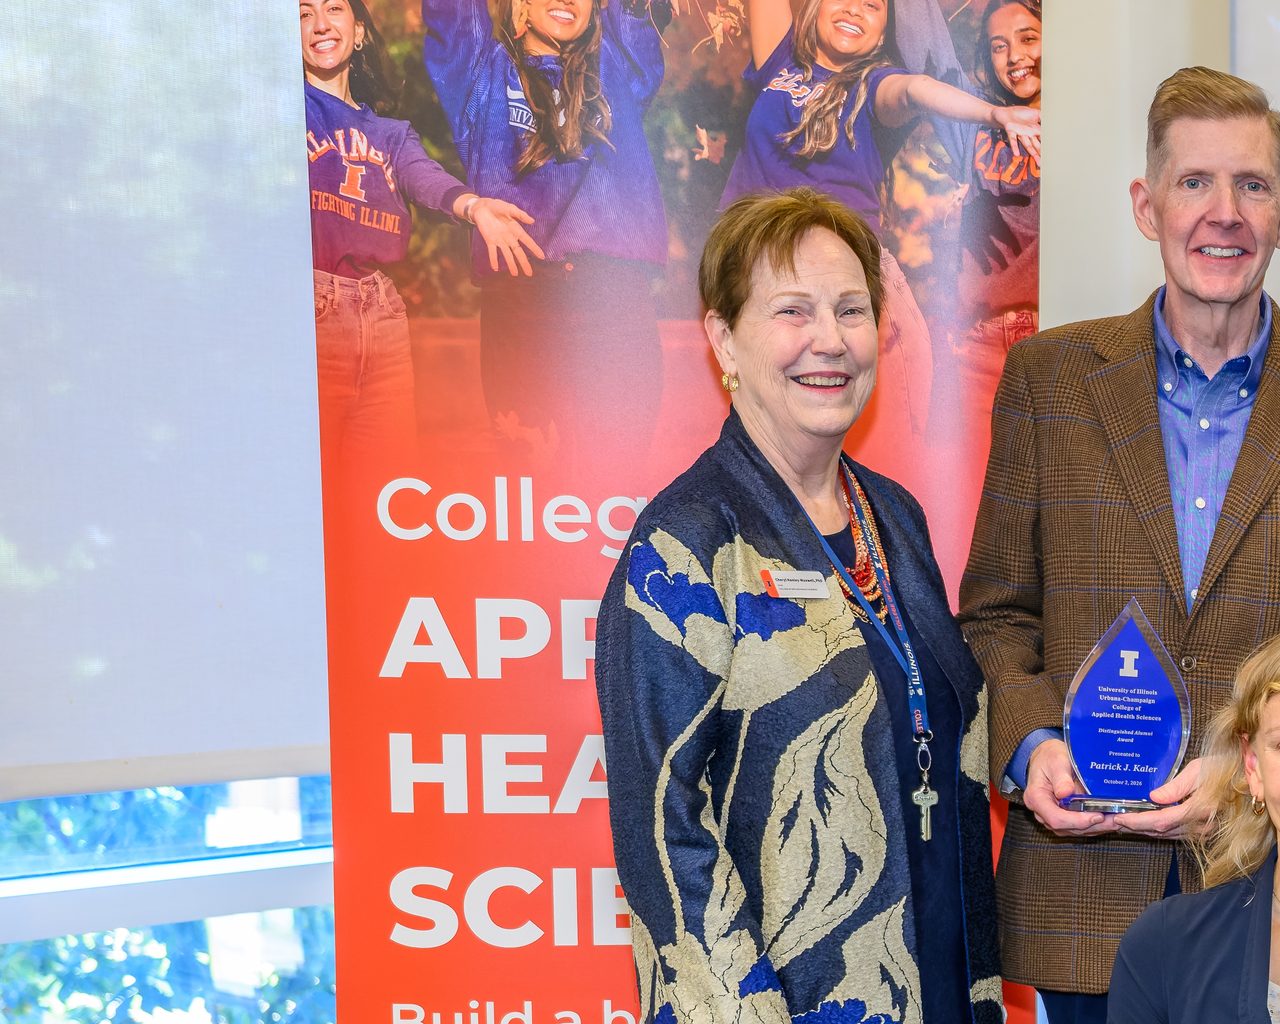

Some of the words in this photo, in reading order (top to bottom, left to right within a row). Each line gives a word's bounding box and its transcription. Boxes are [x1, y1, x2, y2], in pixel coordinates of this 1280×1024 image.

[311, 190, 356, 221] FIGHTING
[376, 476, 648, 560] Colleg
[862, 519, 879, 560] ILLINOIS
[903, 641, 921, 685] ILLINOIS
[1119, 649, 1139, 678] I
[1098, 686, 1128, 694] University
[1099, 695, 1156, 704] Urbana-Champaign
[1090, 761, 1122, 771] Patrick
[1133, 764, 1158, 773] Kaler
